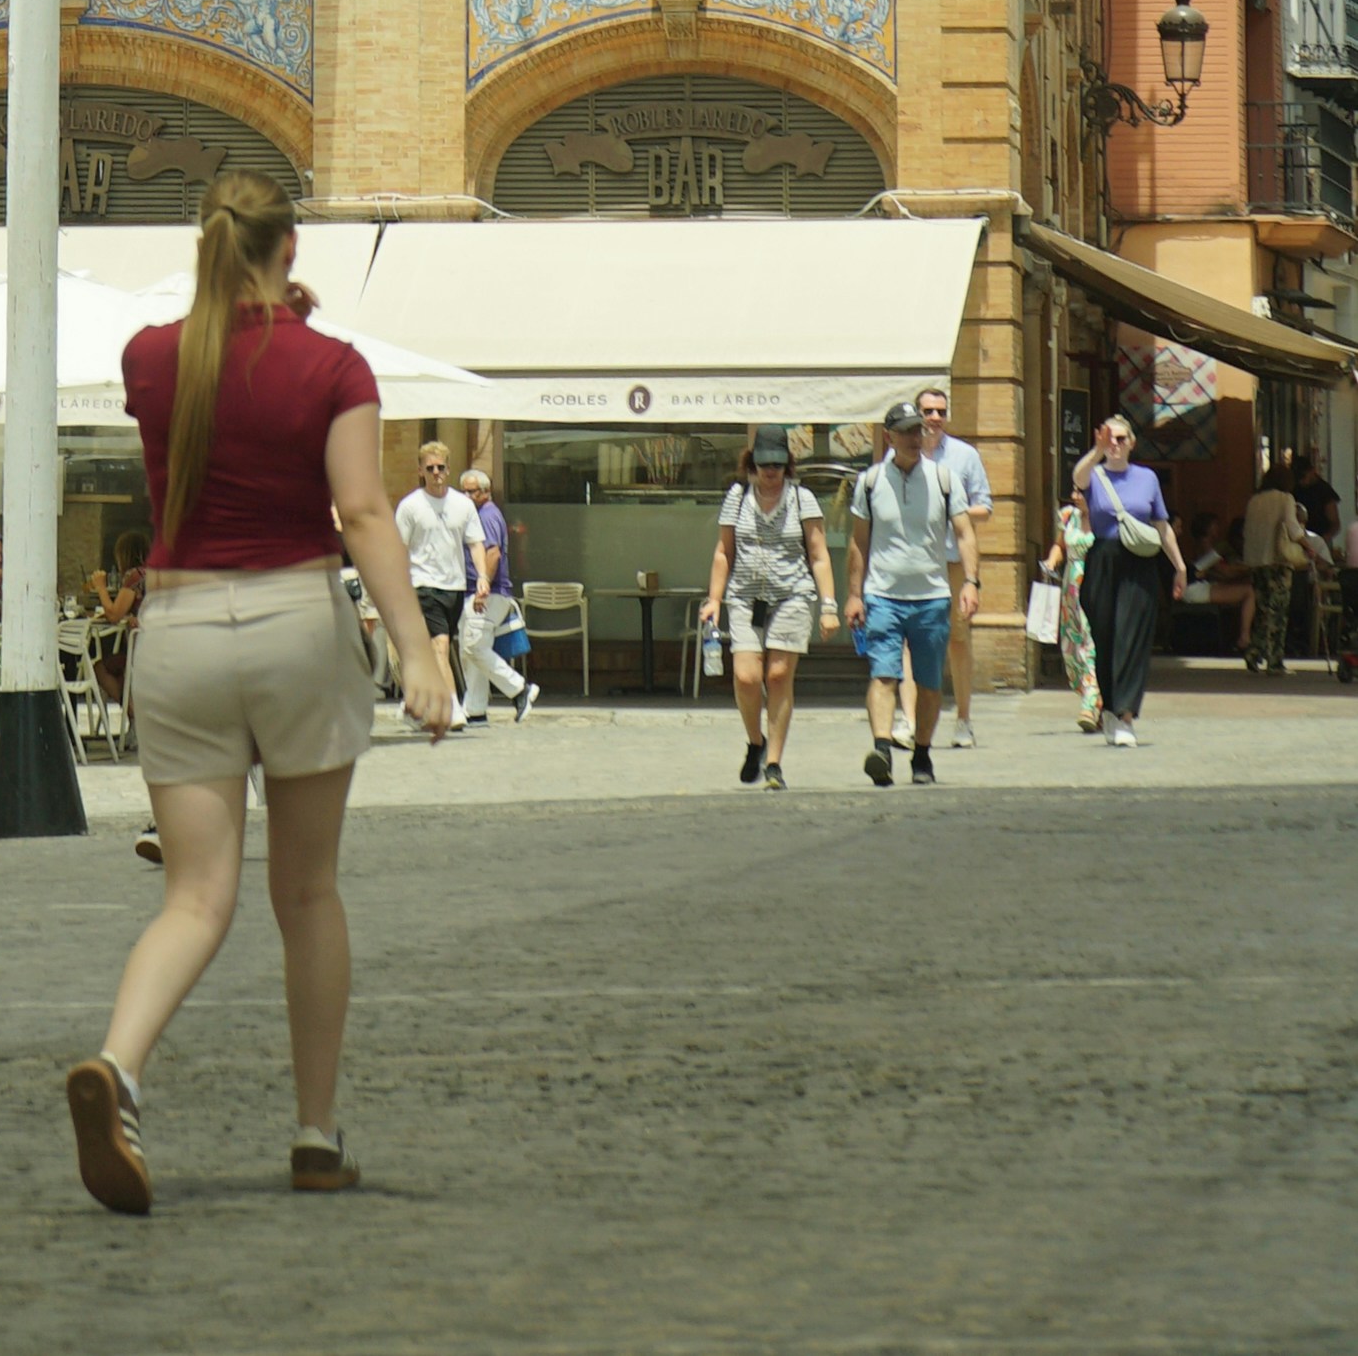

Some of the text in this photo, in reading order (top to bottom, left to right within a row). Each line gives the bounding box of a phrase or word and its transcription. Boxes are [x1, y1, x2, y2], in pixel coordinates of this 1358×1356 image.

[69, 108, 153, 142] LAREDO
[611, 107, 767, 138] ROBLES LAREDO
[60, 139, 113, 216] AR
[648, 137, 724, 206] BAR
[540, 394, 608, 406] ROBLES
[671, 394, 705, 406] BAR
[713, 394, 781, 406] LAREDO
